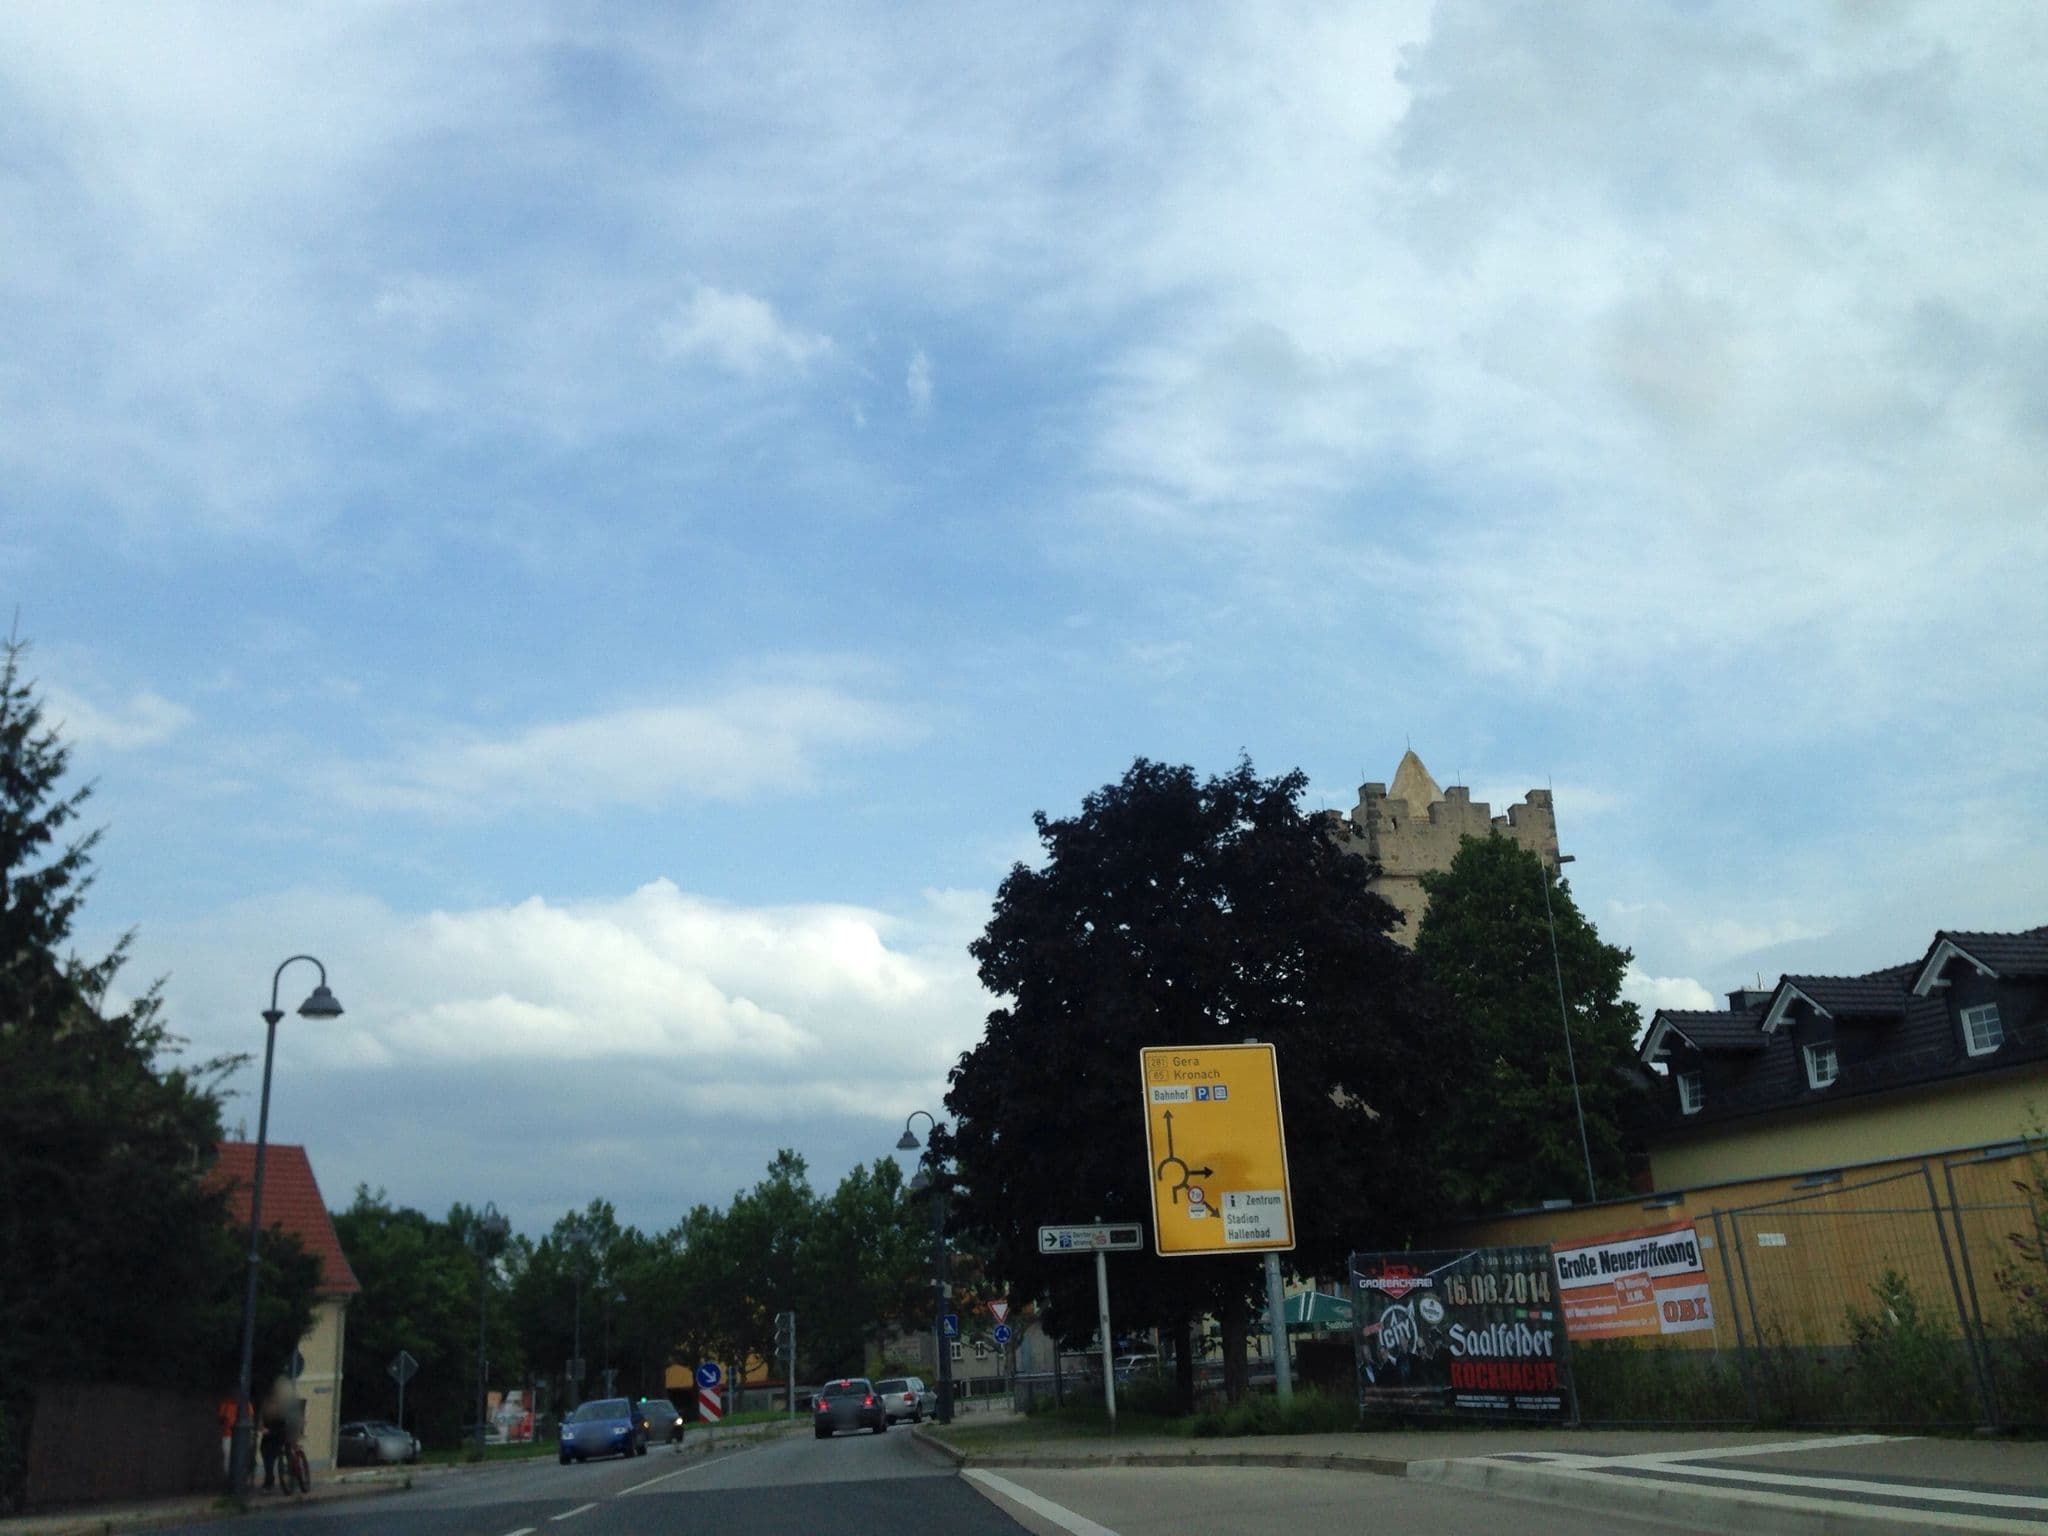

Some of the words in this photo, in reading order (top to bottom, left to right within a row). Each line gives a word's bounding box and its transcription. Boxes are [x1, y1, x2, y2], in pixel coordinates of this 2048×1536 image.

[1173, 1056, 1200, 1067] Gera
[1174, 1069, 1221, 1080] Kronach
[1154, 1089, 1188, 1101] Bahnhof
[1246, 1194, 1281, 1206] Zentrum
[1227, 1214, 1260, 1225] Stadion
[1228, 1228, 1271, 1240] Hallenbad
[1558, 1251, 1598, 1280] Große
[1598, 1239, 1698, 1274] Neueröffnung
[1443, 1271, 1550, 1305] 16.08.2014
[1663, 1296, 1708, 1323] OBI
[1449, 1322, 1554, 1357] Saalfelder
[1450, 1361, 1559, 1390] ROCKNACHT
